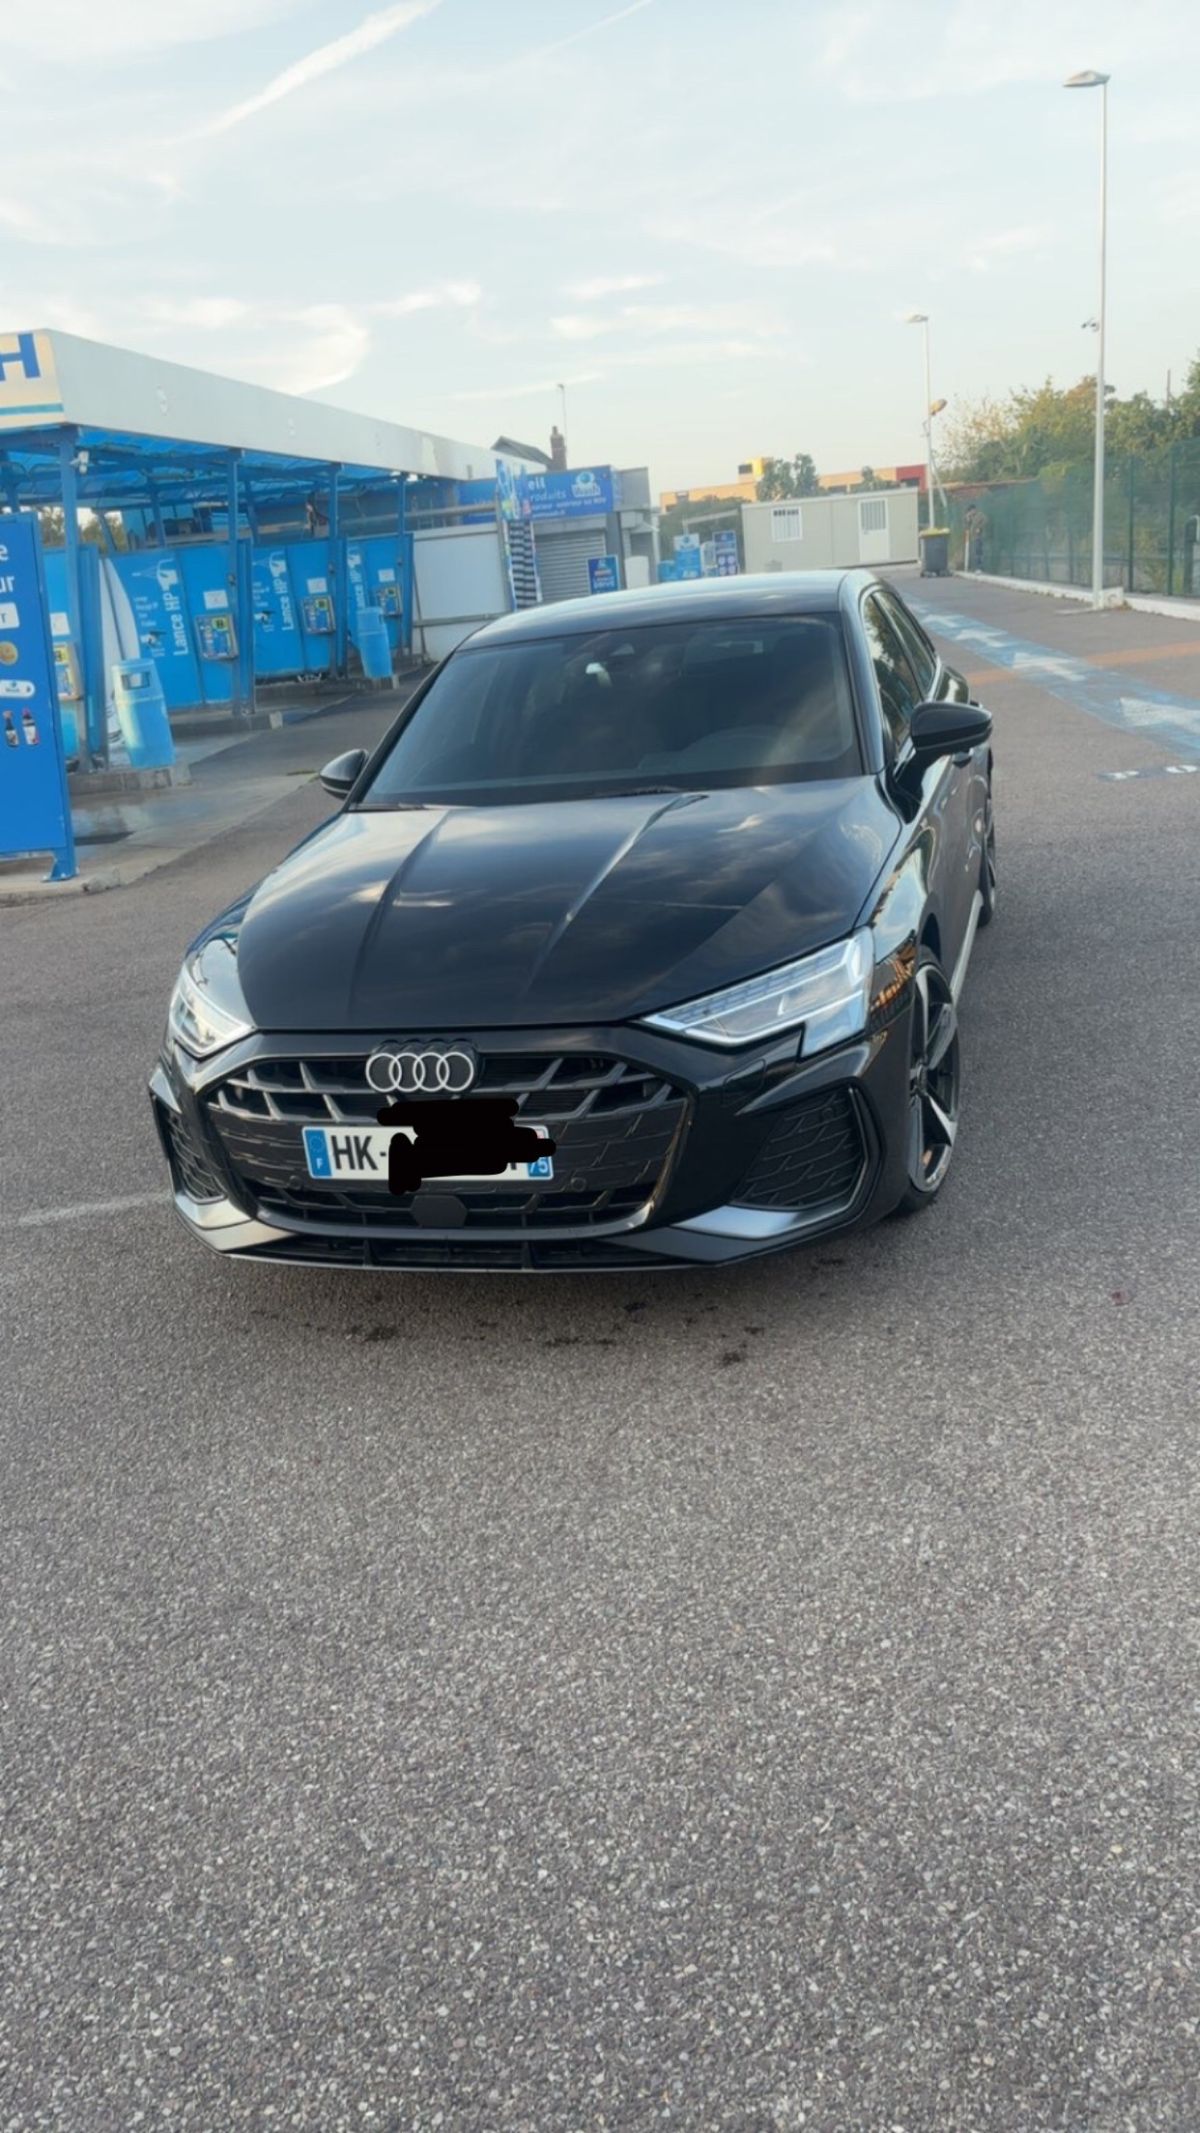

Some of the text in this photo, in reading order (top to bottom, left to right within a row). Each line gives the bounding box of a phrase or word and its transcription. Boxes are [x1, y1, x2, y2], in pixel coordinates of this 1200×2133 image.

[0, 333, 41, 381] H
[163, 592, 189, 656] Lance HP
[273, 578, 294, 631] Lance HP
[316, 1158, 323, 1170] F
